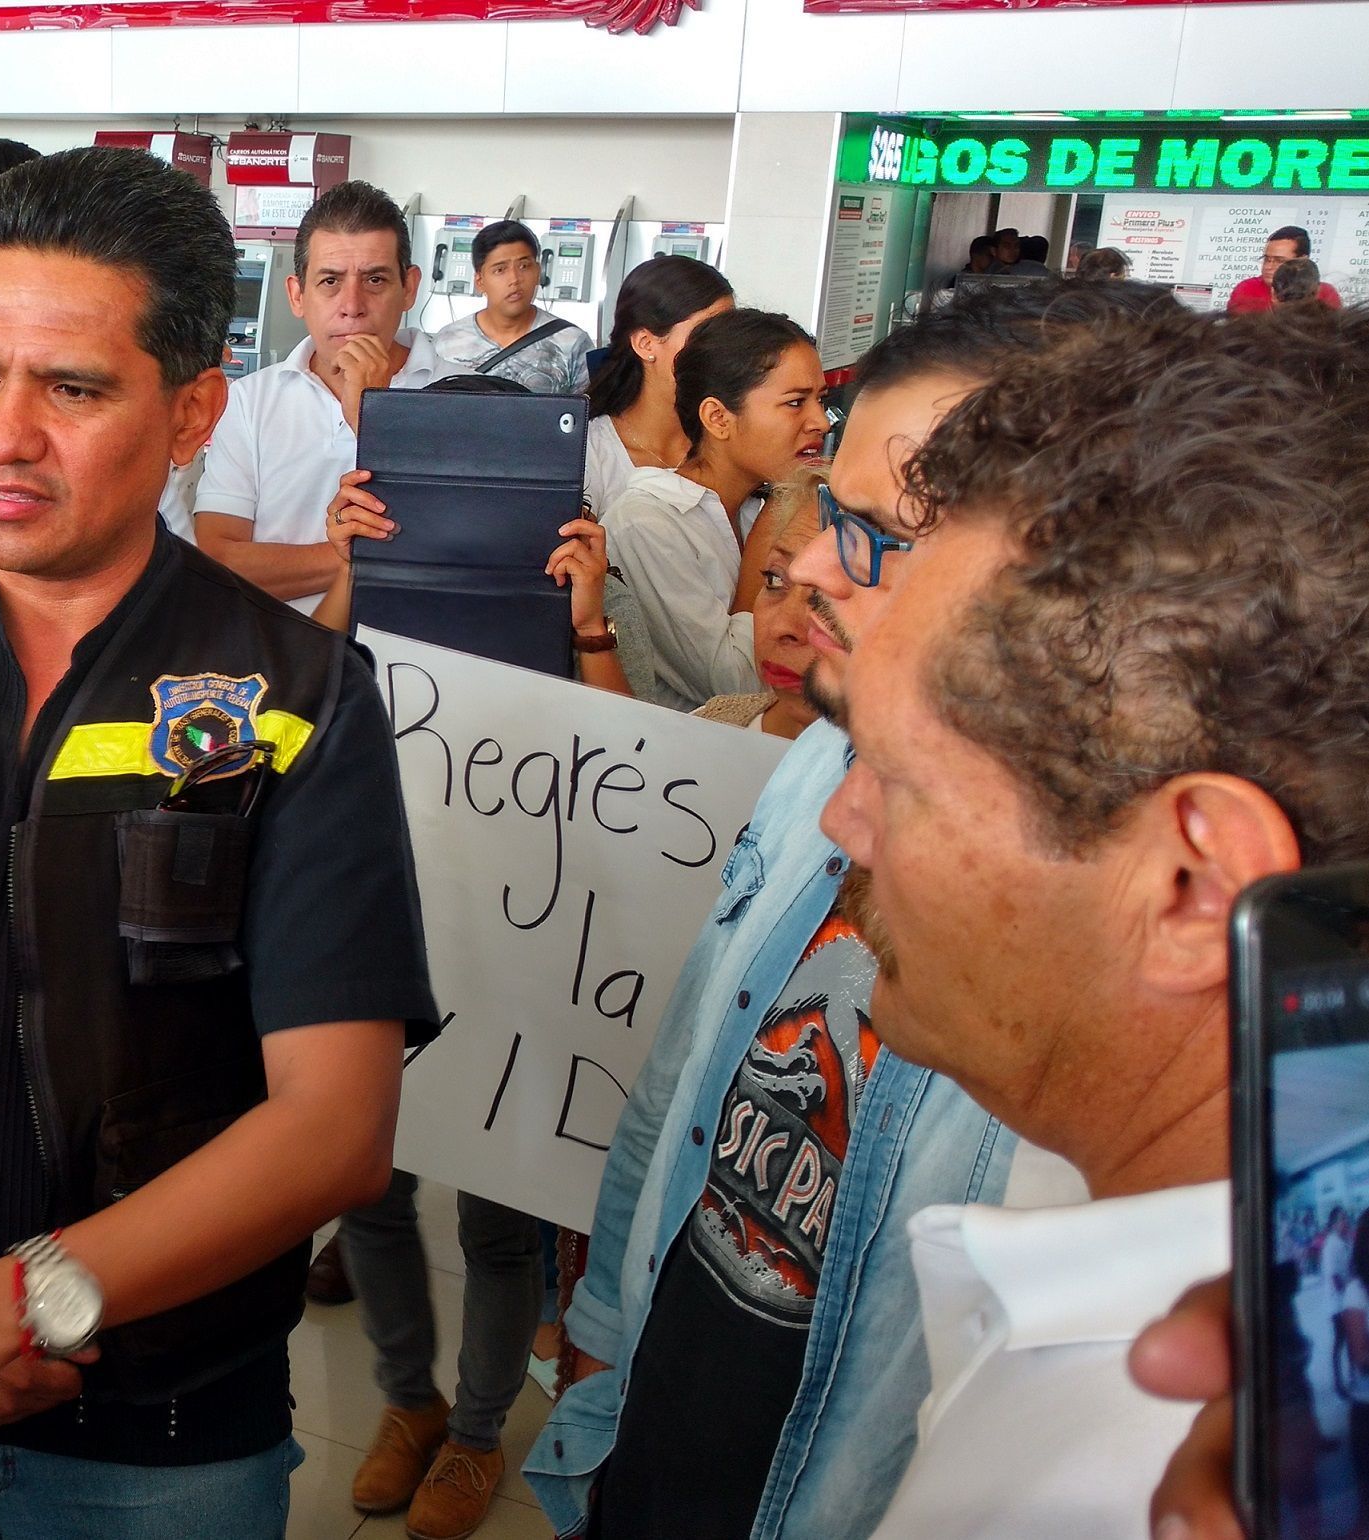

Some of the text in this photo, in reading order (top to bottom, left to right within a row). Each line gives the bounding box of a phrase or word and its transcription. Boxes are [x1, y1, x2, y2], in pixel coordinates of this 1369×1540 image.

[183, 154, 207, 164] BANORTE
[239, 157, 287, 166] BANORTE
[322, 155, 345, 164] BANORTE
[1045, 138, 1141, 187] DE
[1126, 210, 1160, 218] ENVIOS
[1229, 208, 1272, 216] OCOTLAN
[1157, 219, 1175, 228] Plus
[1238, 227, 1269, 235] BARCA
[1209, 235, 1233, 243] VISTA
[207, 680, 237, 693] GENERAL
[572, 890, 645, 1028] la
